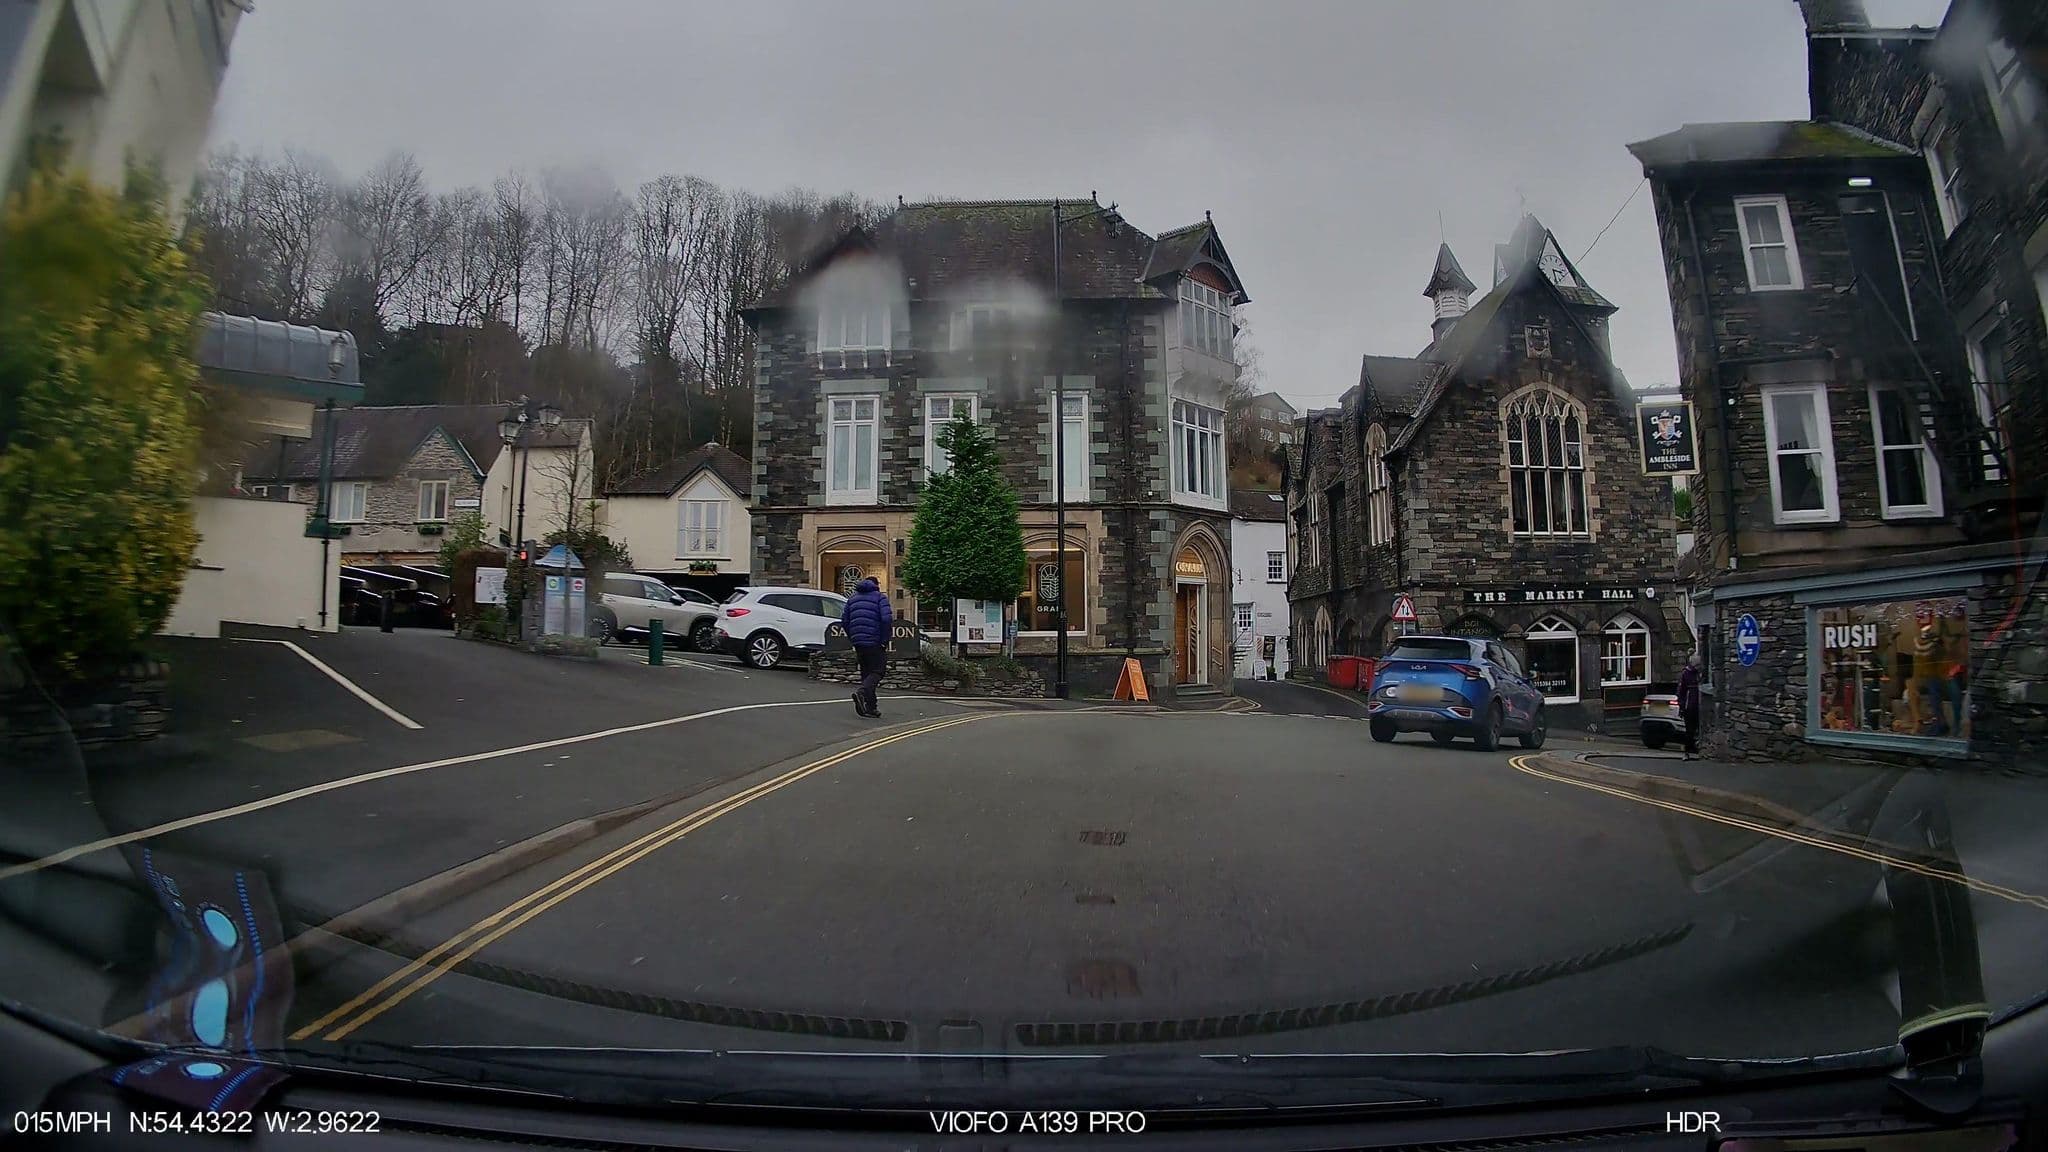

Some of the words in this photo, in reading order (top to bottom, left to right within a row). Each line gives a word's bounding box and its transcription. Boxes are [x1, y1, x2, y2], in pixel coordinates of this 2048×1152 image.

[1649, 455, 1691, 464] AMBLESIDE
[1473, 592, 1507, 602] THE
[1525, 590, 1585, 601] MARKET
[1602, 590, 1634, 599] HALL
[1824, 624, 1877, 648] RUSH
